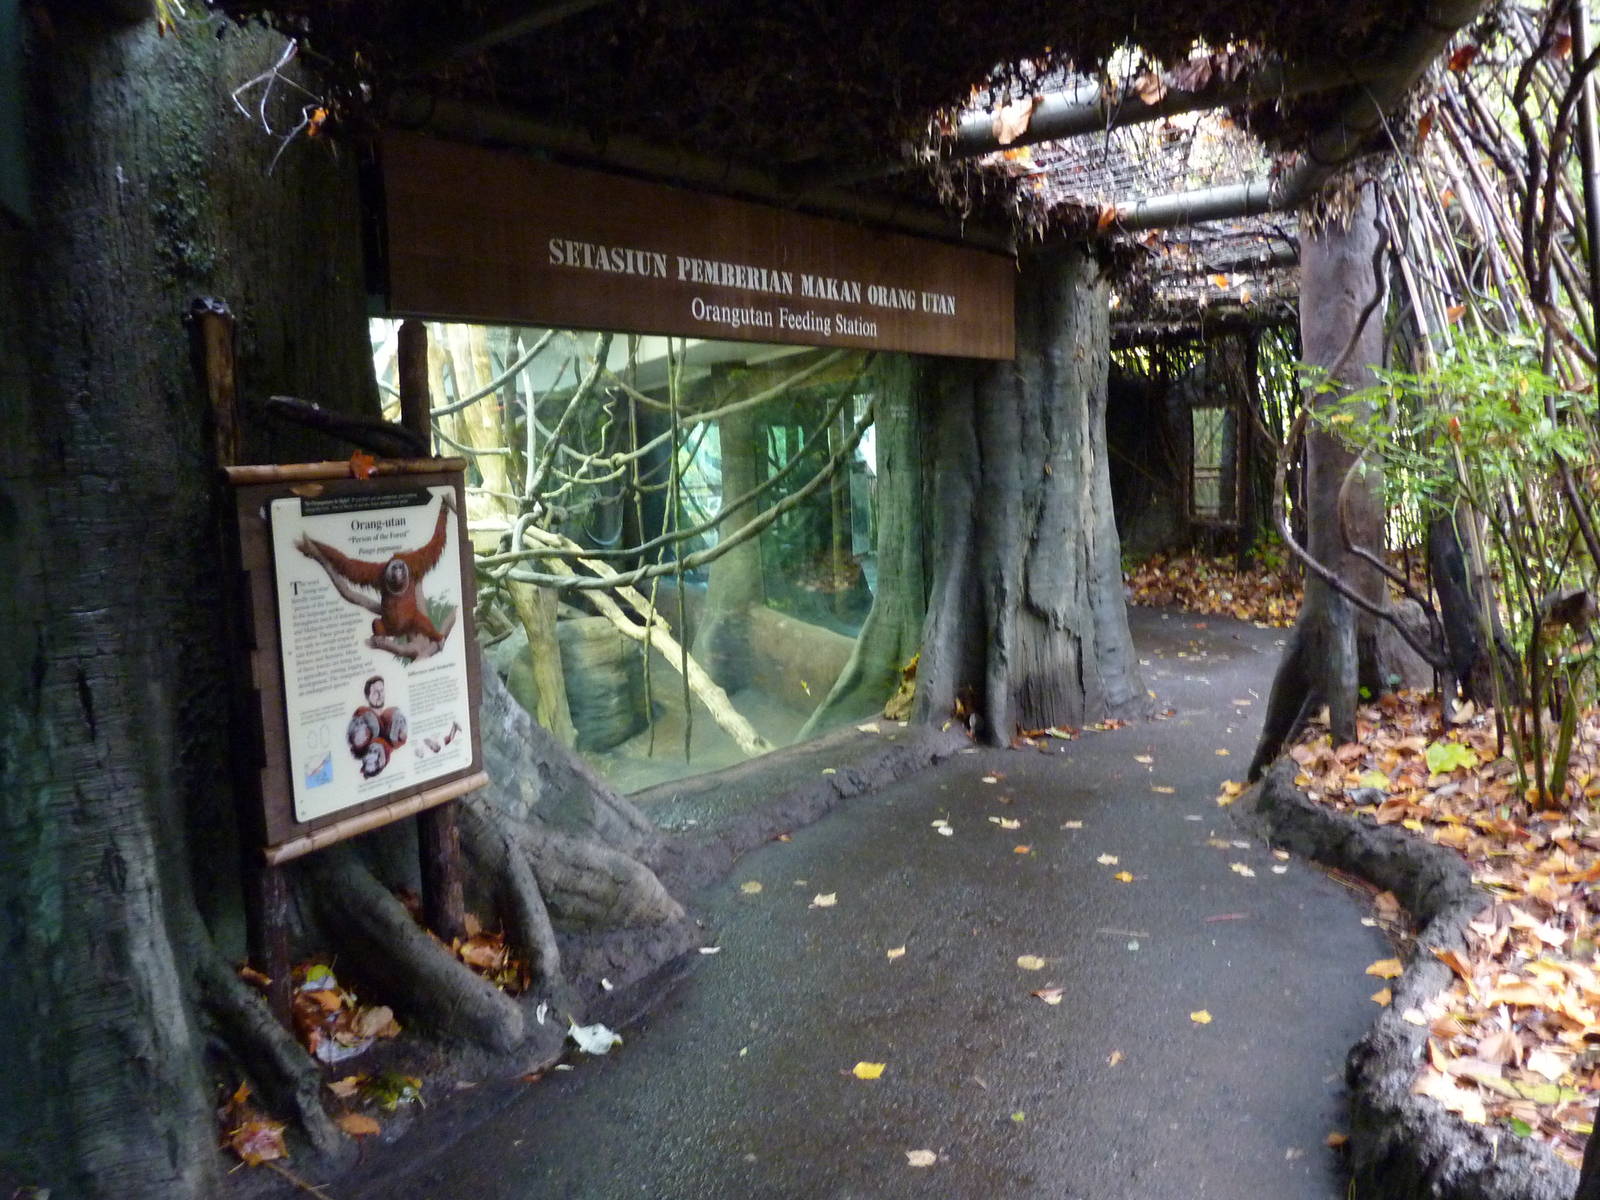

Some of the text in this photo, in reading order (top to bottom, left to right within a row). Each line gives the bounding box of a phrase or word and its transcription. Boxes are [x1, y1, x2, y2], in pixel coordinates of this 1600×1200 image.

[549, 238, 956, 316] SETASIUN PEMBERIAN MAKAN ORANG UTAN
[691, 297, 877, 337] Orangutan Feeding Station
[351, 517, 406, 530] Orang-utan
